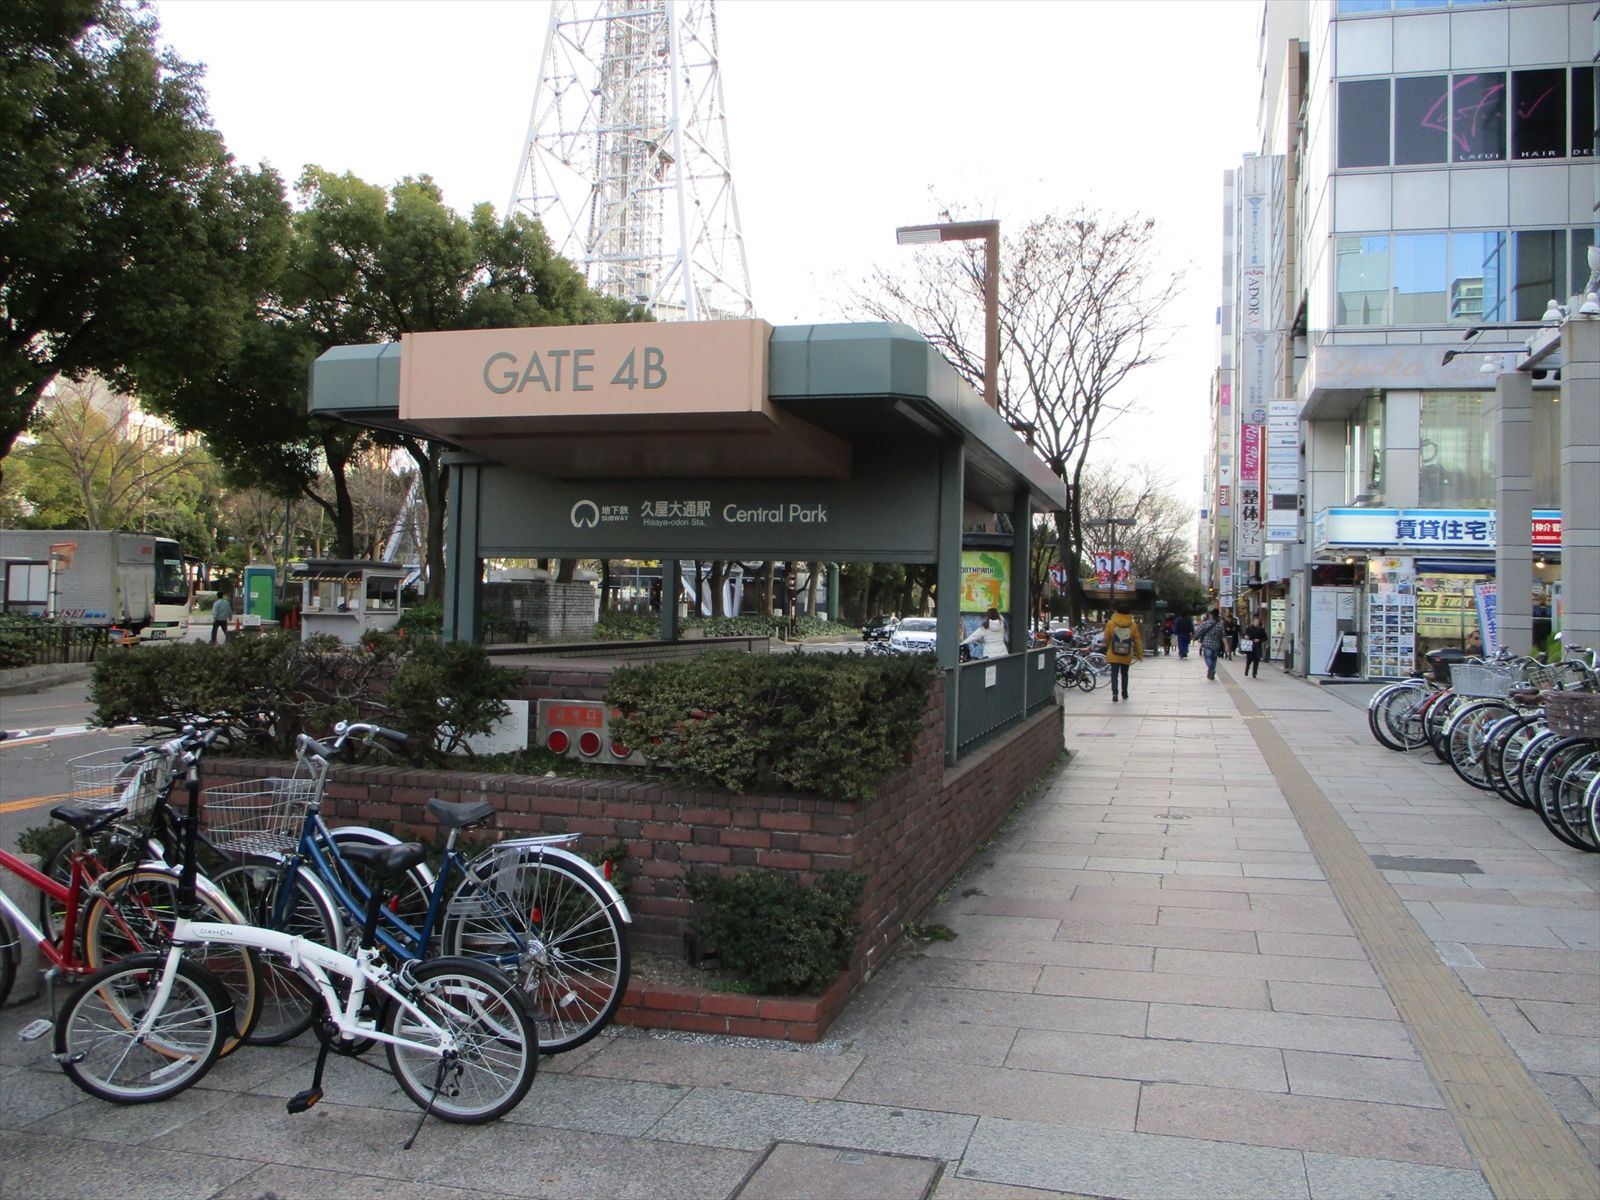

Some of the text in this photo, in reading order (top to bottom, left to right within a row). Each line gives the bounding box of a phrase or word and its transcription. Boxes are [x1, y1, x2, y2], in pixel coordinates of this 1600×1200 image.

[483, 347, 668, 395] GATE 4B
[601, 505, 629, 515] 地下鉄
[641, 500, 711, 518] 久屋大通駅
[723, 504, 828, 523] Central Park
[1242, 489, 1258, 521] 整体
[643, 518, 689, 527] Hisaya-odori
[1395, 520, 1487, 541] 賃貸住宅
[200, 928, 234, 938] DAHON
